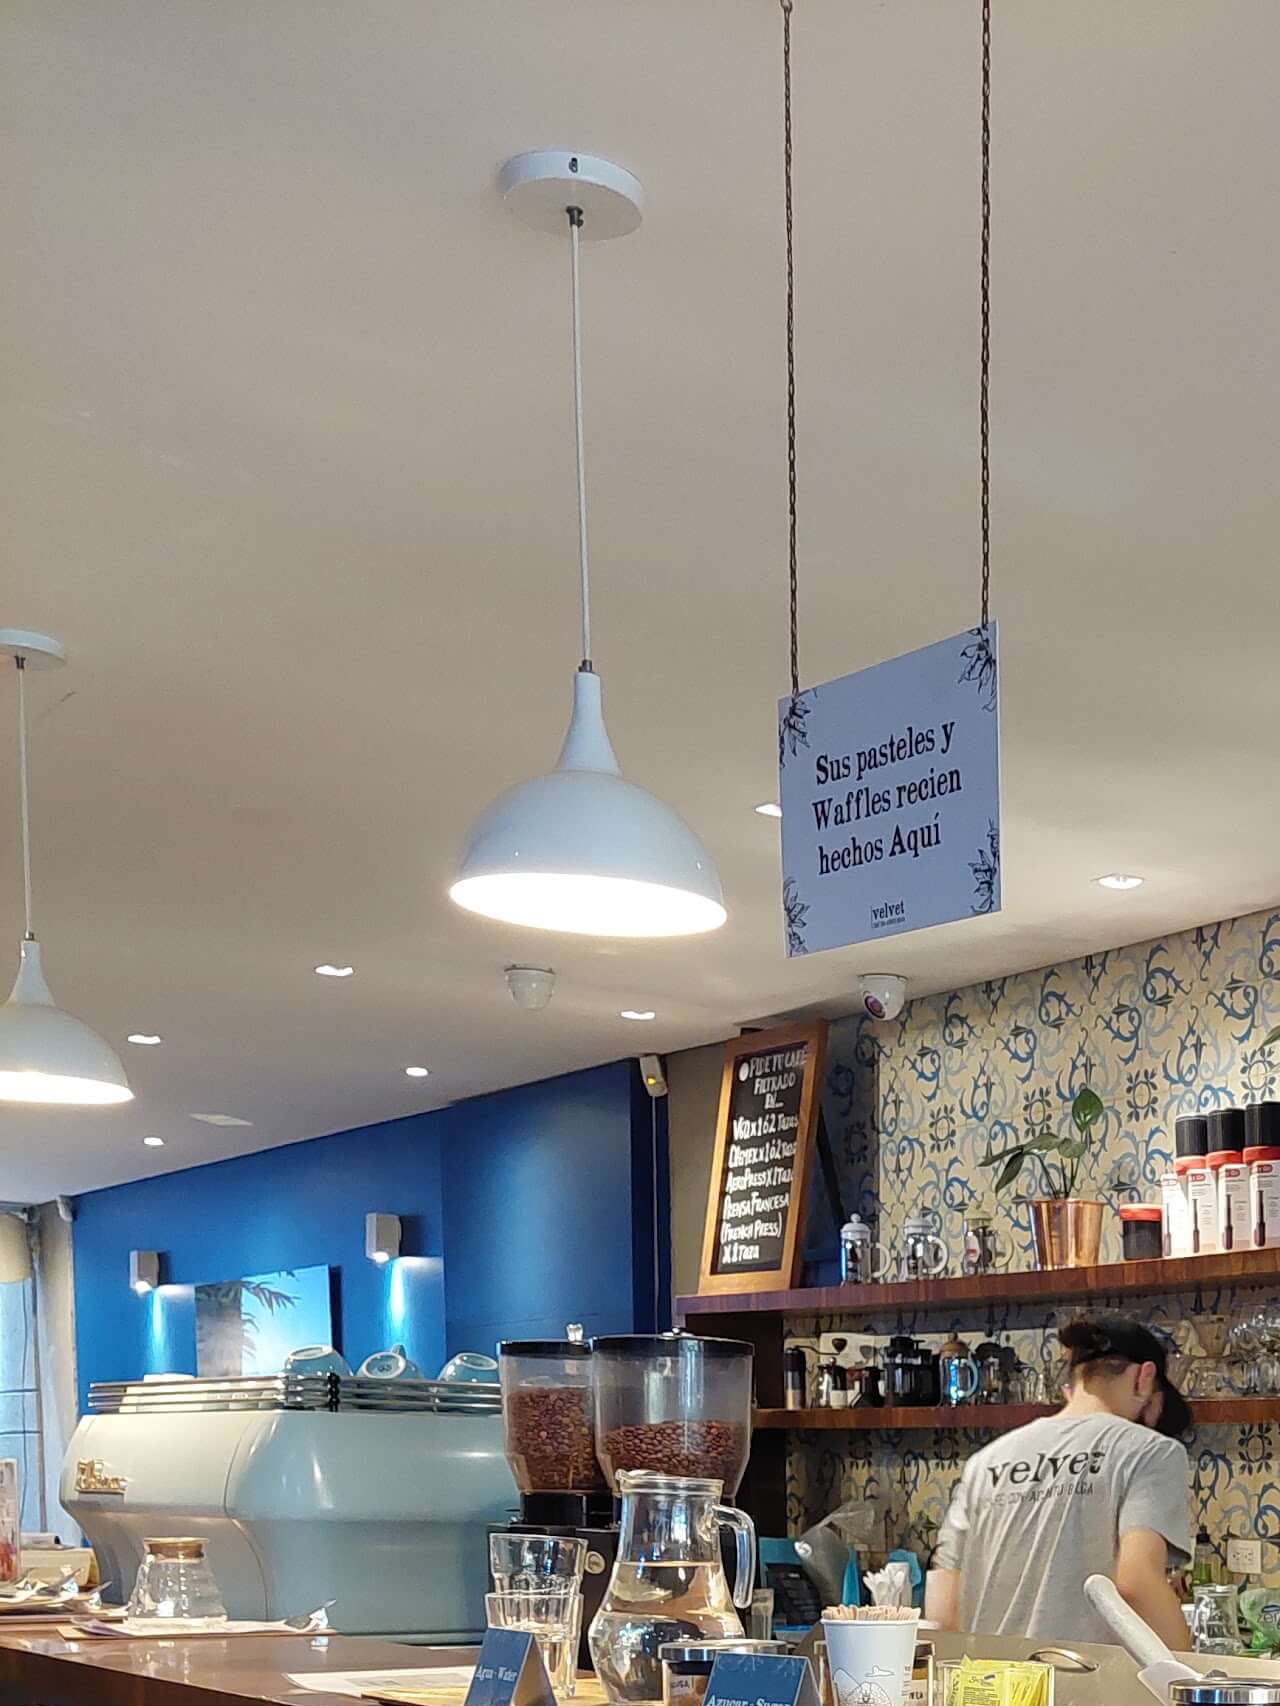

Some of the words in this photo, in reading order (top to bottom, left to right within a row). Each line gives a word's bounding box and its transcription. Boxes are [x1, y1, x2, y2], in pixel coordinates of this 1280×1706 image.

[816, 754, 851, 785] Sus
[856, 726, 935, 781] pasteles
[941, 721, 956, 754] y
[812, 786, 892, 832] Waffles
[896, 768, 962, 809] recien
[818, 836, 883, 876] hechos
[889, 813, 941, 858] Aquí
[871, 900, 905, 920] velvet
[987, 1451, 1105, 1488] velvet
